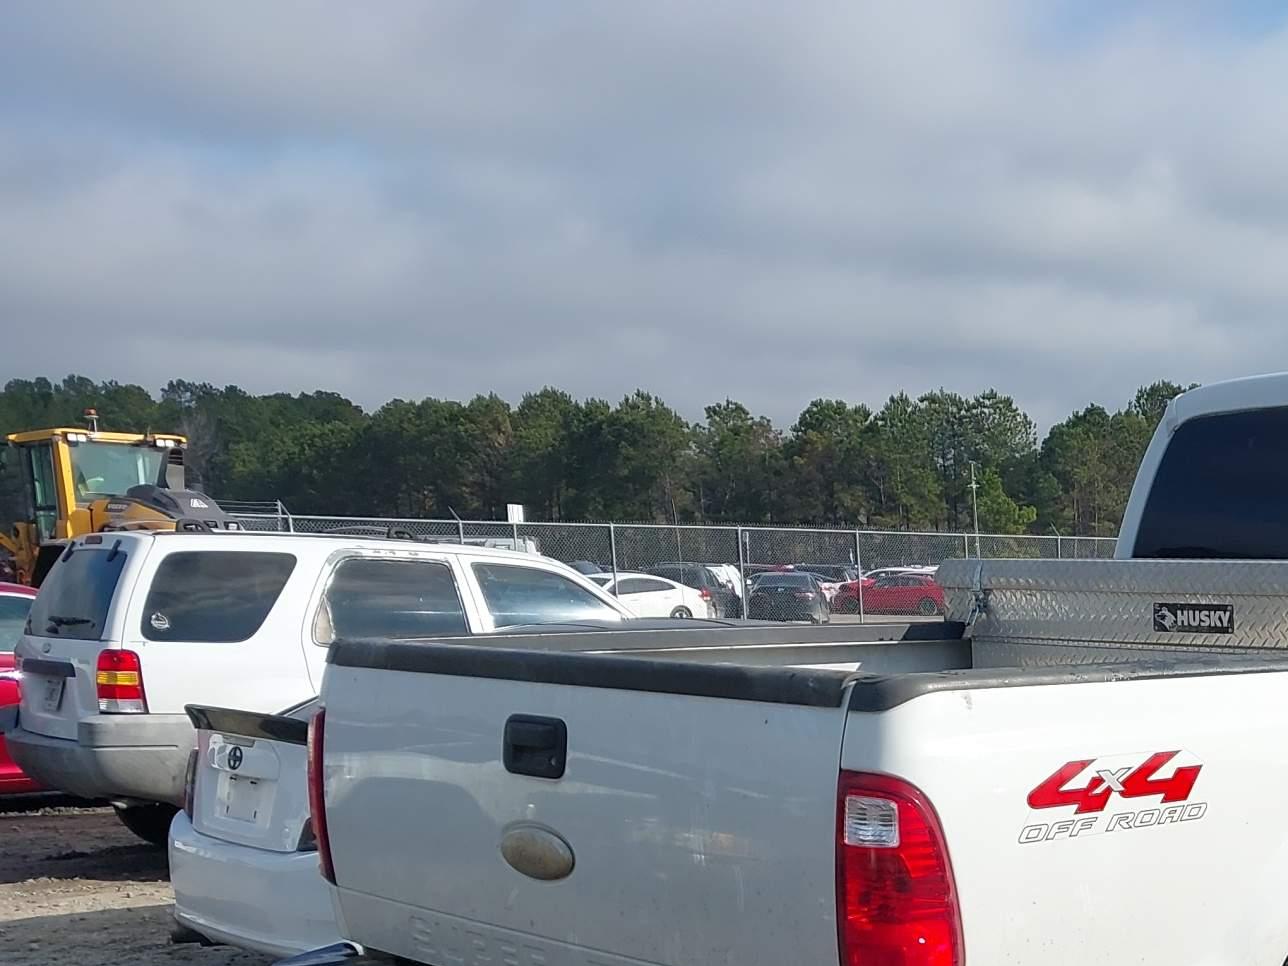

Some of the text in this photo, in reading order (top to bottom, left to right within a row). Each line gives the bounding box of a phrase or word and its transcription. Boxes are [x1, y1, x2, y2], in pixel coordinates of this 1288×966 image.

[1176, 609, 1230, 628] HUSKY
[1018, 802, 1208, 844] OFF ROAD
